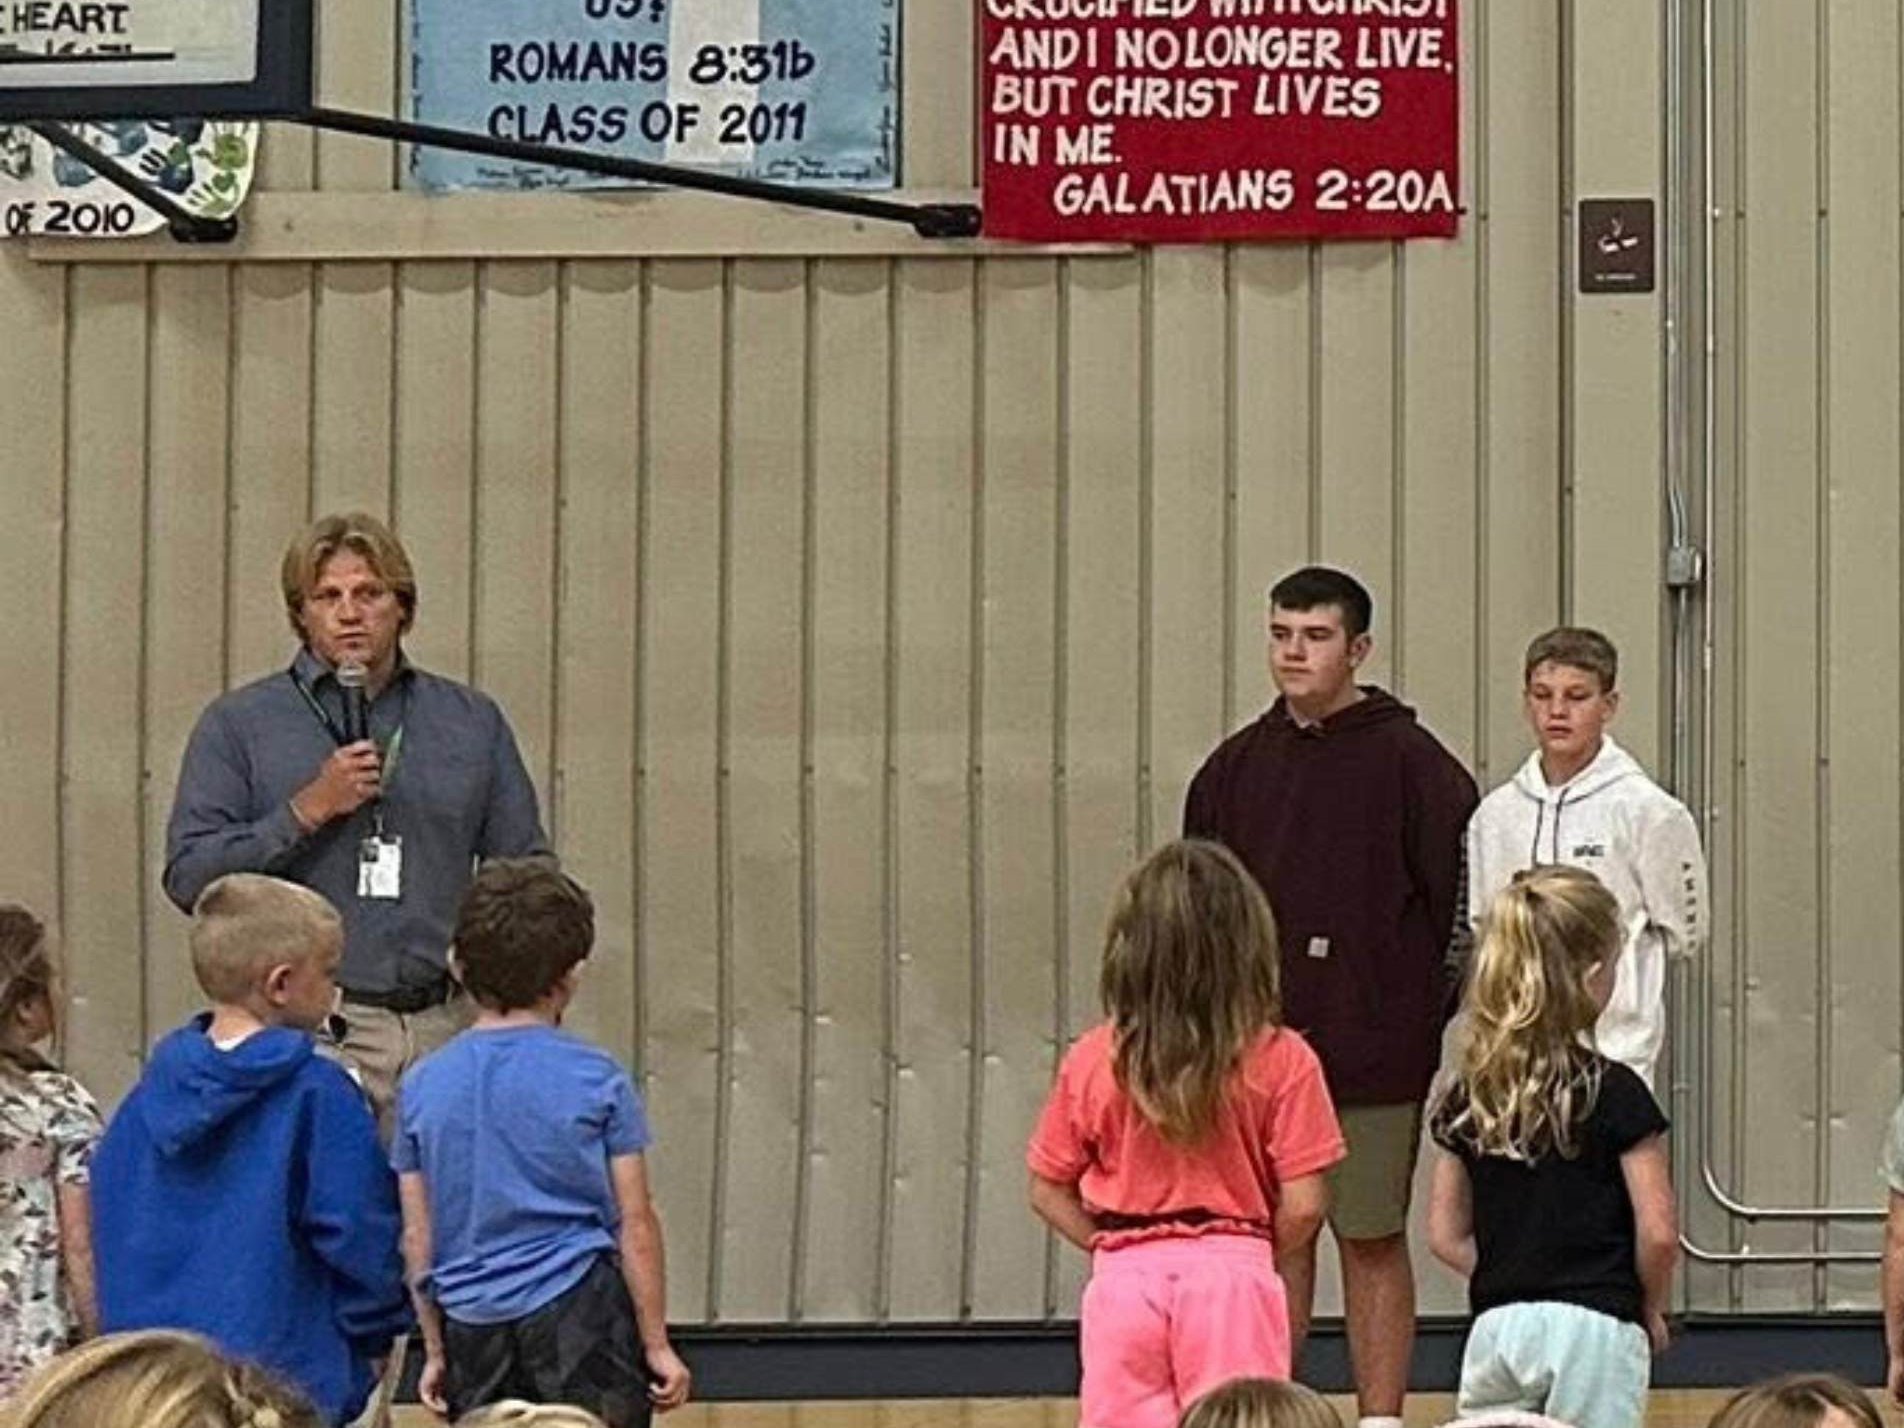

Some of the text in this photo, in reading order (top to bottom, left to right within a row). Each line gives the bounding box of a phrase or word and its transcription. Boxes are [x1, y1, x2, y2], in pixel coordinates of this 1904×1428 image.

[13, 2, 129, 33] HEART
[490, 41, 815, 84] ROMANS 8:31b
[989, 27, 1079, 69] AND
[1087, 28, 1098, 68] I
[1116, 28, 1180, 70] NO
[1187, 28, 1342, 69] LONGER
[993, 75, 1381, 117] BUT CHRIST LIVES
[488, 102, 807, 145] CLASS OF 2011
[995, 125, 1122, 165] IN ME.
[1054, 172, 1294, 215] GALATIANS
[6, 201, 134, 234] OF 2010
